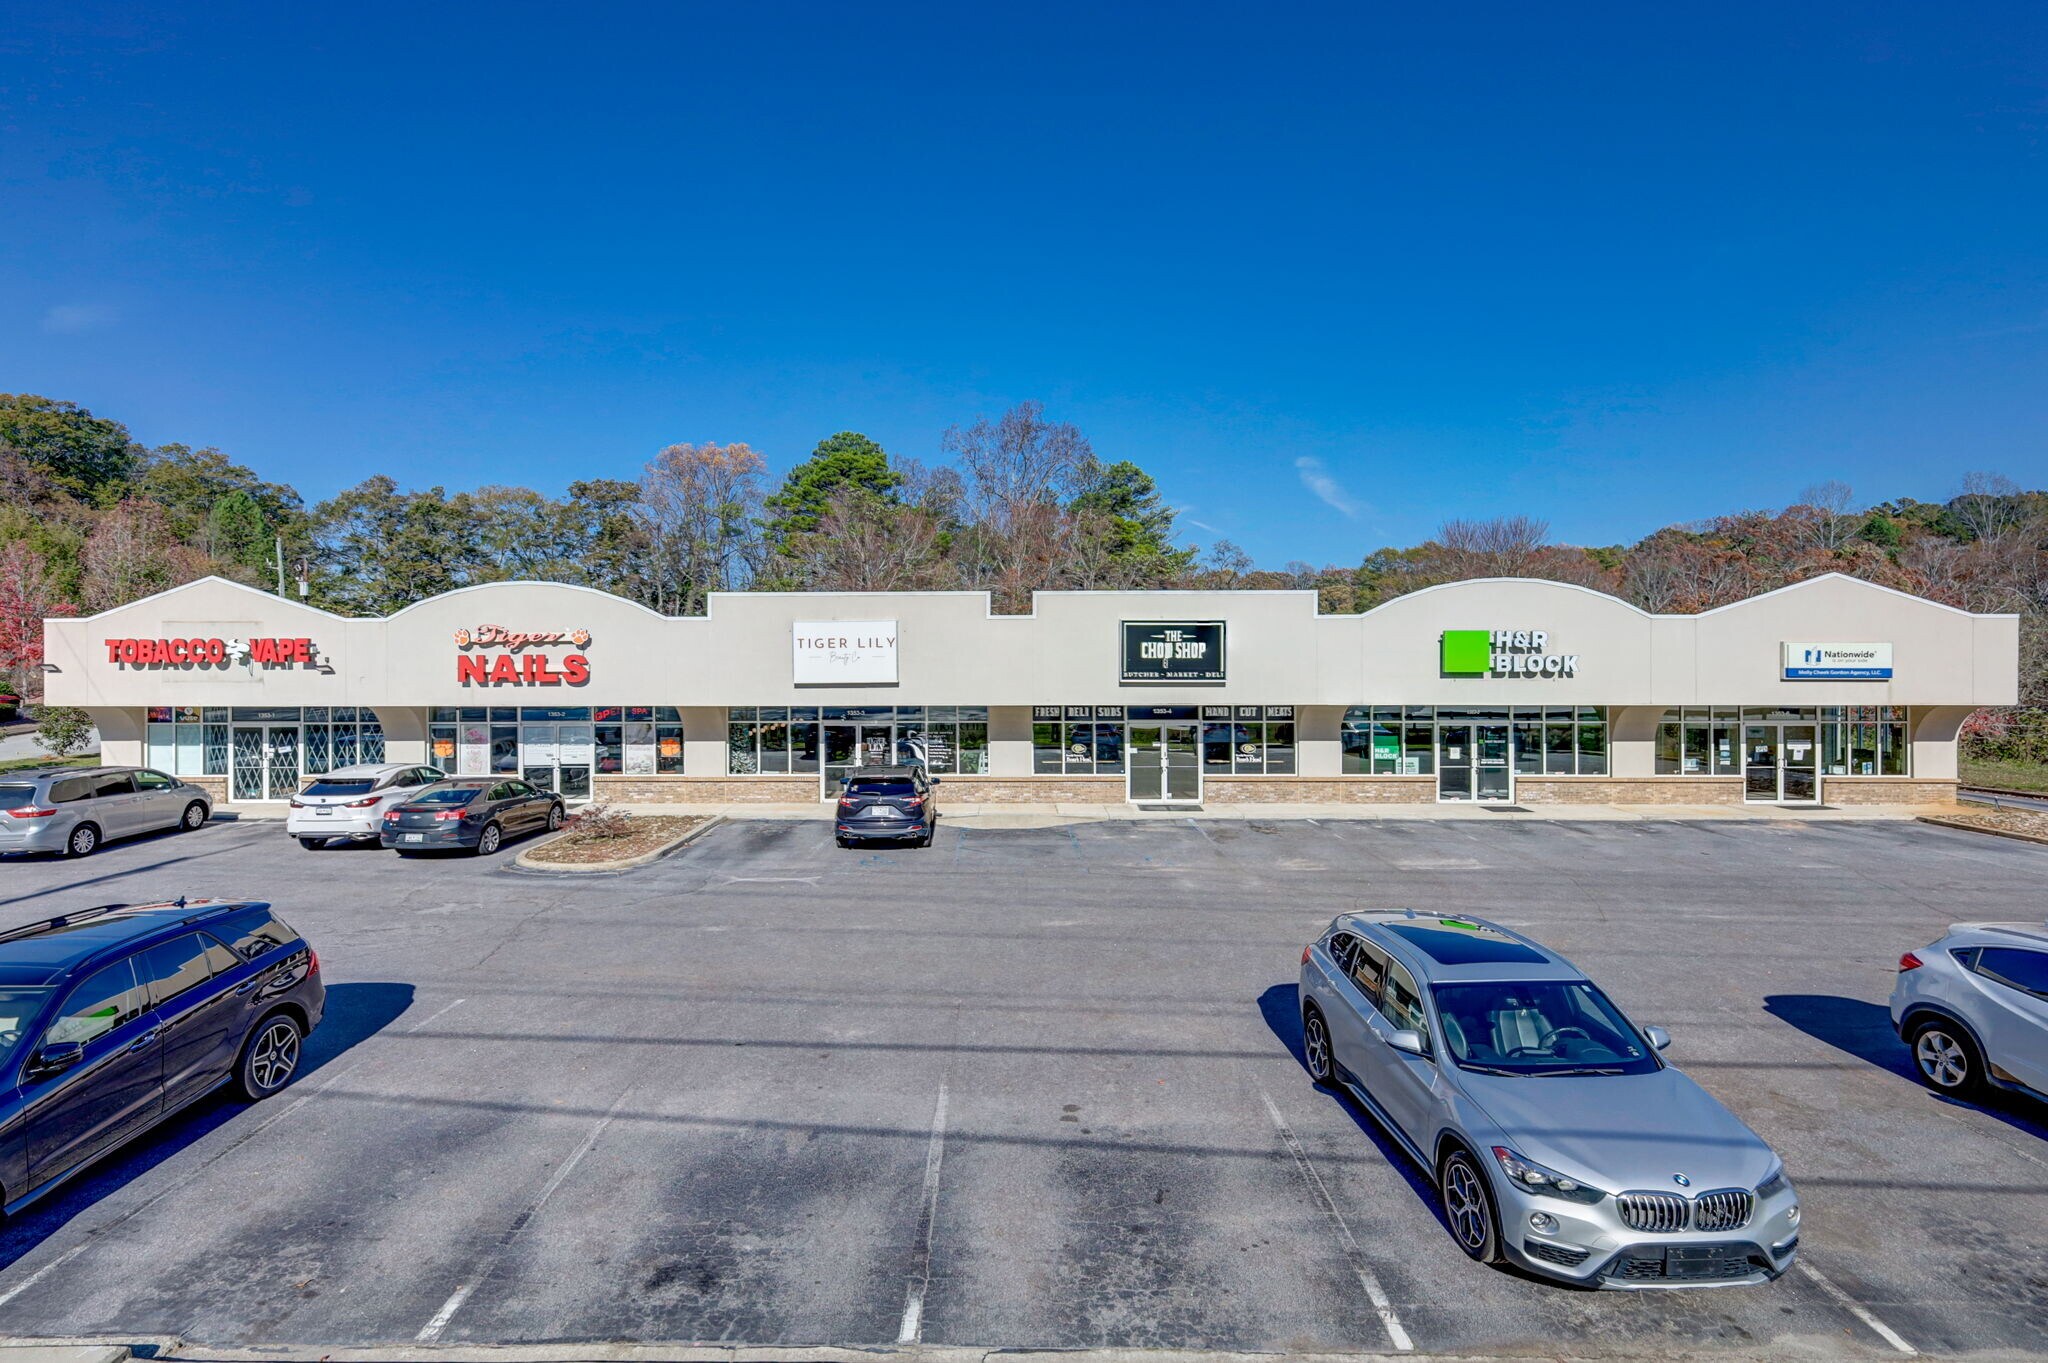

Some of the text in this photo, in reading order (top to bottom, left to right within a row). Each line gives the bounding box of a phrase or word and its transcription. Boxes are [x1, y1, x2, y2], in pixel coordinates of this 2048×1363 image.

[475, 624, 565, 649] Tiger
[1164, 630, 1183, 642] THE
[1496, 630, 1548, 648] H&R
[797, 637, 895, 649] TIGER LILY
[105, 638, 312, 663] TOBACCO VAPE
[1175, 642, 1206, 659] SHOP
[1824, 650, 1876, 658] Nationwide
[458, 654, 589, 683] NAILS
[1496, 655, 1579, 672] BLOCK
[631, 707, 649, 715] SPA
[1035, 707, 1060, 717] FRESH
[1067, 707, 1090, 717] DELI
[1097, 707, 1122, 717] SUBS
[1205, 706, 1229, 717] HAND
[1239, 706, 1257, 717] CUT
[1267, 706, 1292, 717] MEATS
